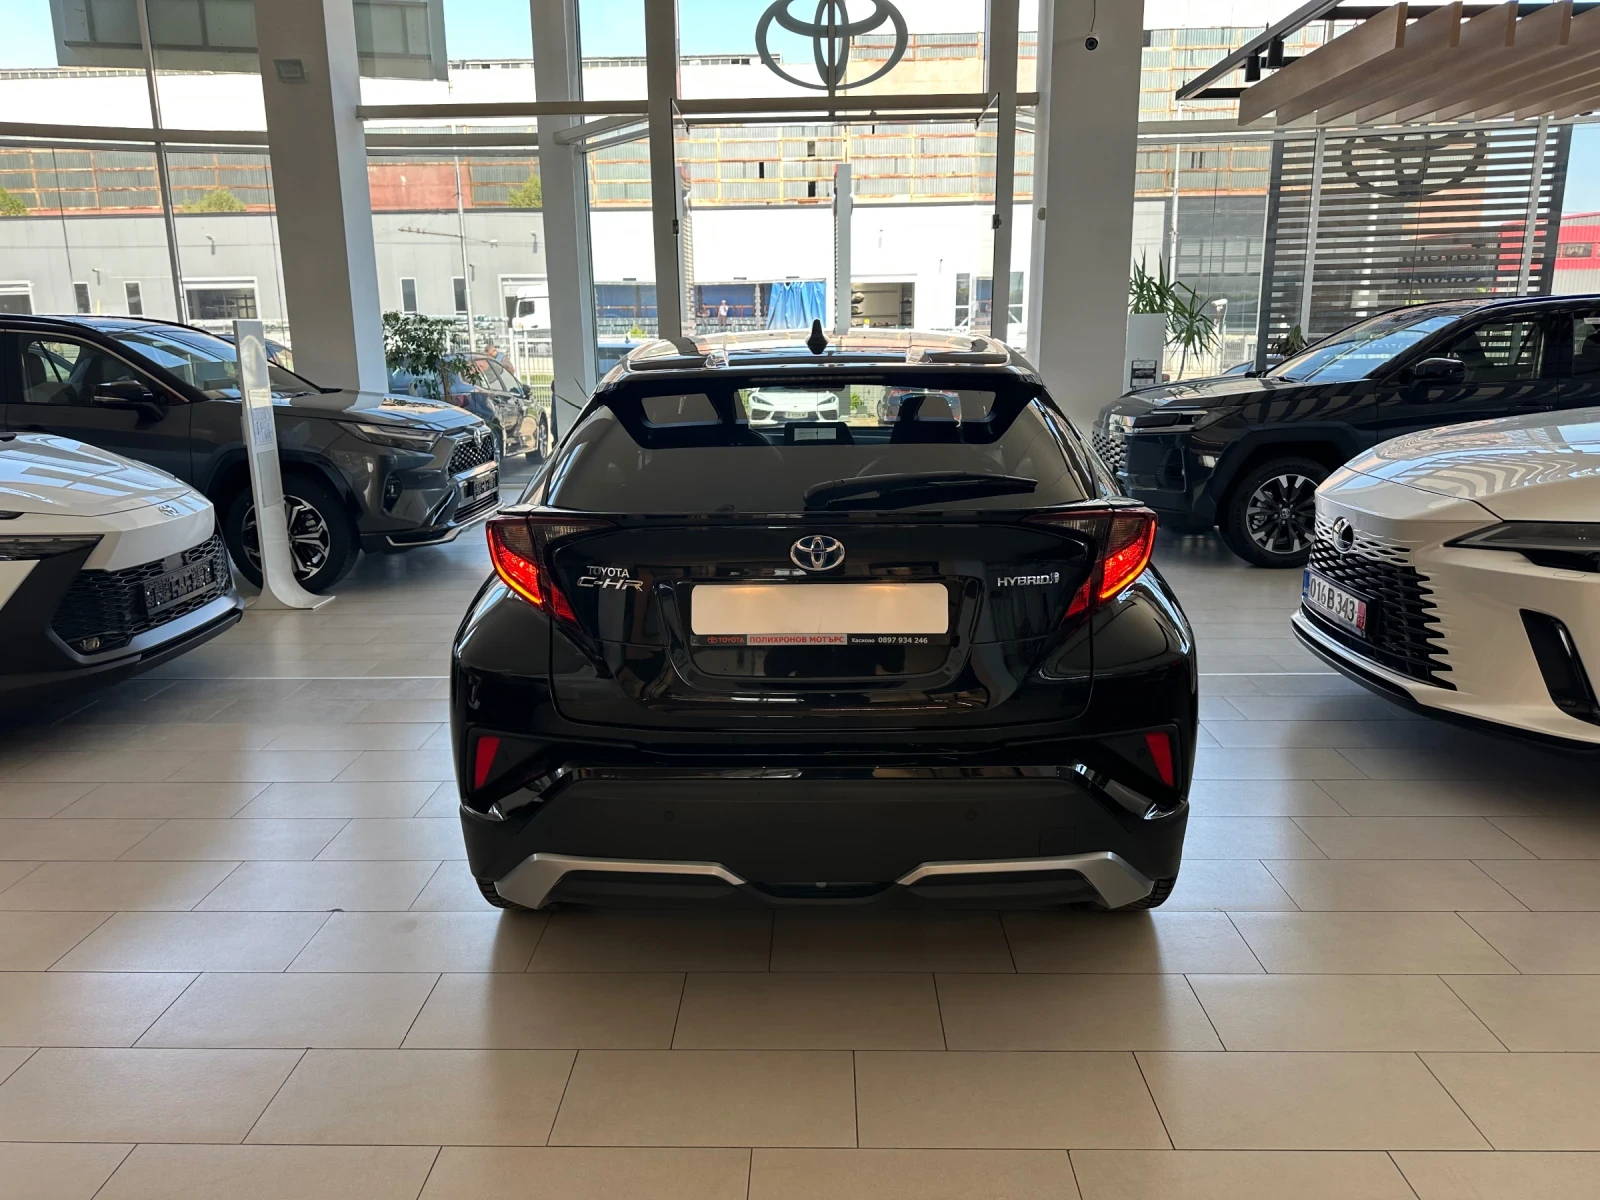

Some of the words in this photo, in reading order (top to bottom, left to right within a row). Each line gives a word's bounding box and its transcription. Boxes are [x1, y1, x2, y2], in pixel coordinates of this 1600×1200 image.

[587, 565, 630, 578] TOYOTA
[577, 576, 643, 592] C-HR
[997, 575, 1051, 587] HYBRID
[878, 636, 897, 644] 0897
[898, 636, 913, 644] 934
